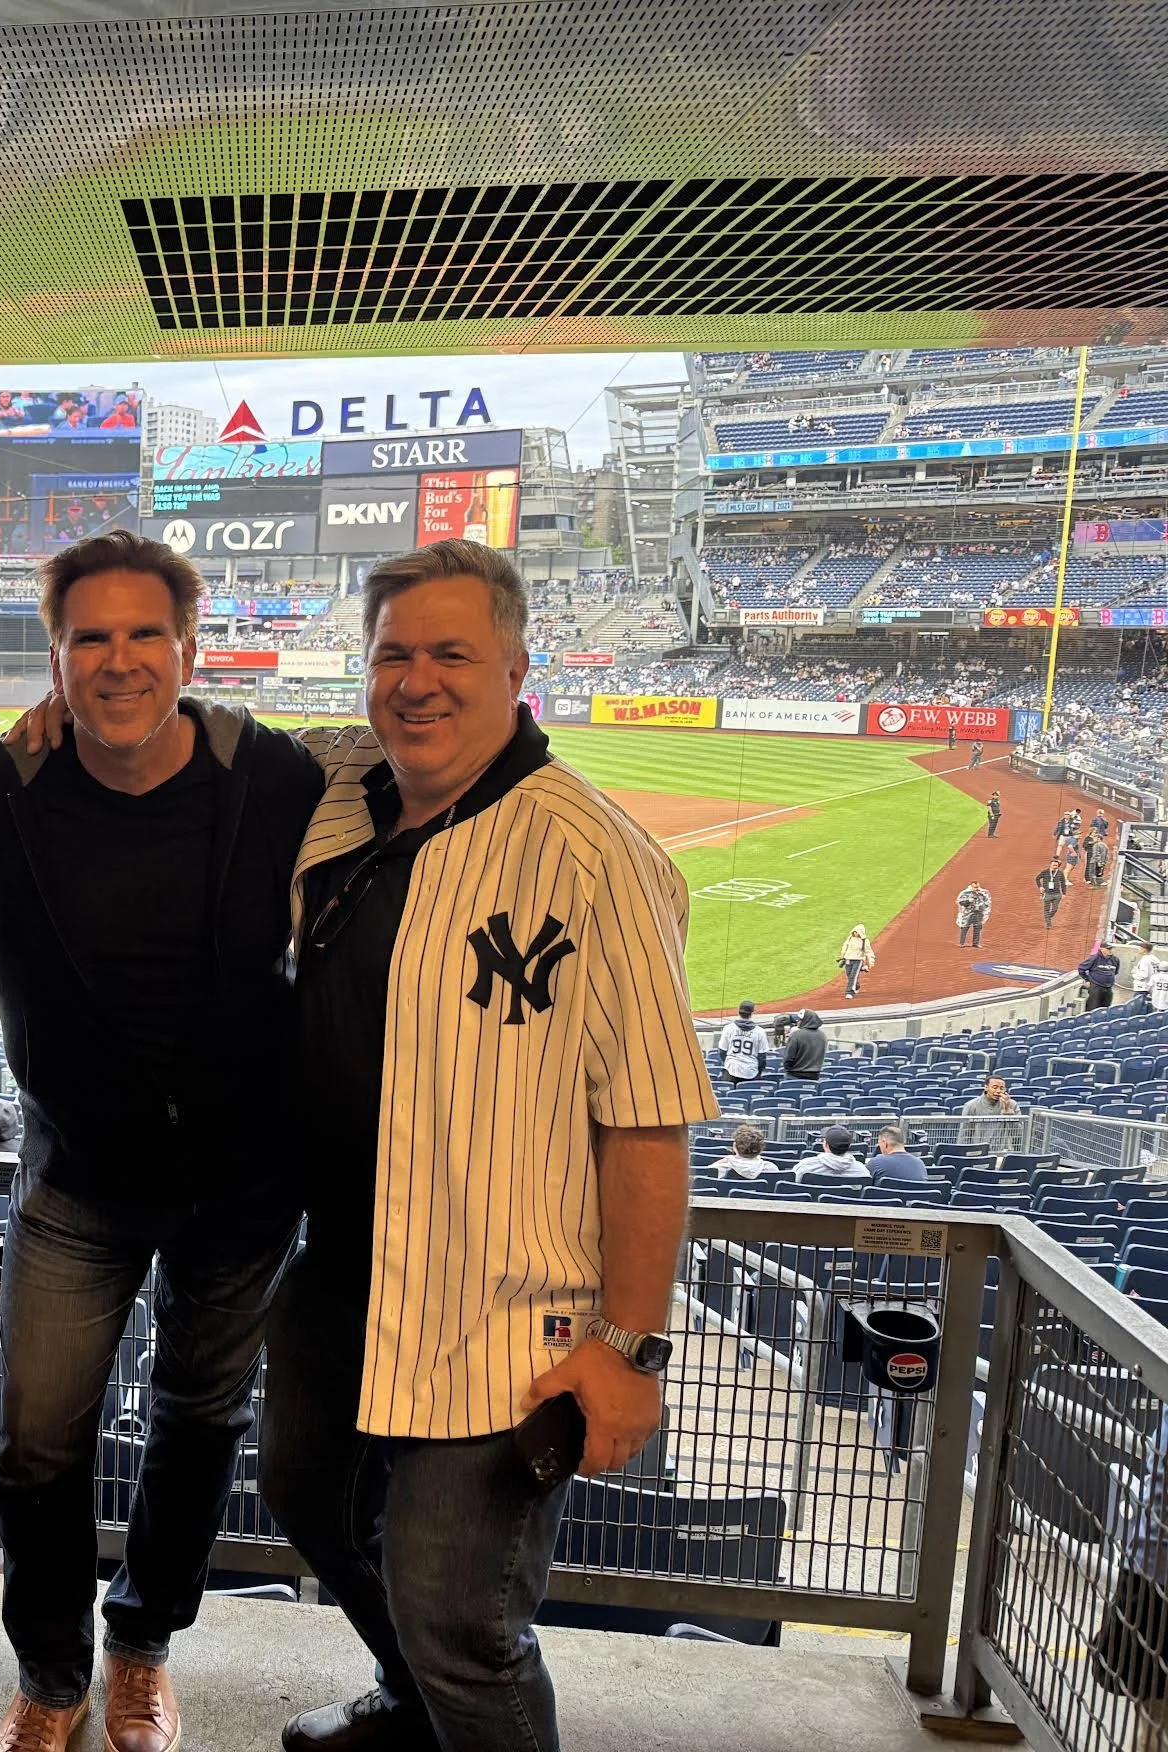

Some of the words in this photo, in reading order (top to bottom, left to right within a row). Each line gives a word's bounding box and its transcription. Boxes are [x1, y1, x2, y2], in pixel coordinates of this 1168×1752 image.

[291, 387, 493, 437] DELTA
[371, 439, 469, 469] STARR
[424, 477, 457, 488] This
[424, 491, 463, 505] Bud's
[326, 501, 410, 526] DKNY
[423, 505, 449, 519] For
[744, 502, 757, 511] CUP
[422, 519, 454, 532] You.
[206, 519, 295, 551] razr
[744, 610, 770, 621] Parts
[771, 608, 819, 622] Authority
[725, 710, 756, 719] BANK
[759, 711, 773, 719] OF
[775, 711, 829, 722] AMERICA
[945, 711, 998, 727] WEBB
[465, 911, 577, 1025] NY
[731, 1039, 754, 1056] 99
[889, 1364, 926, 1377] PEPSI
